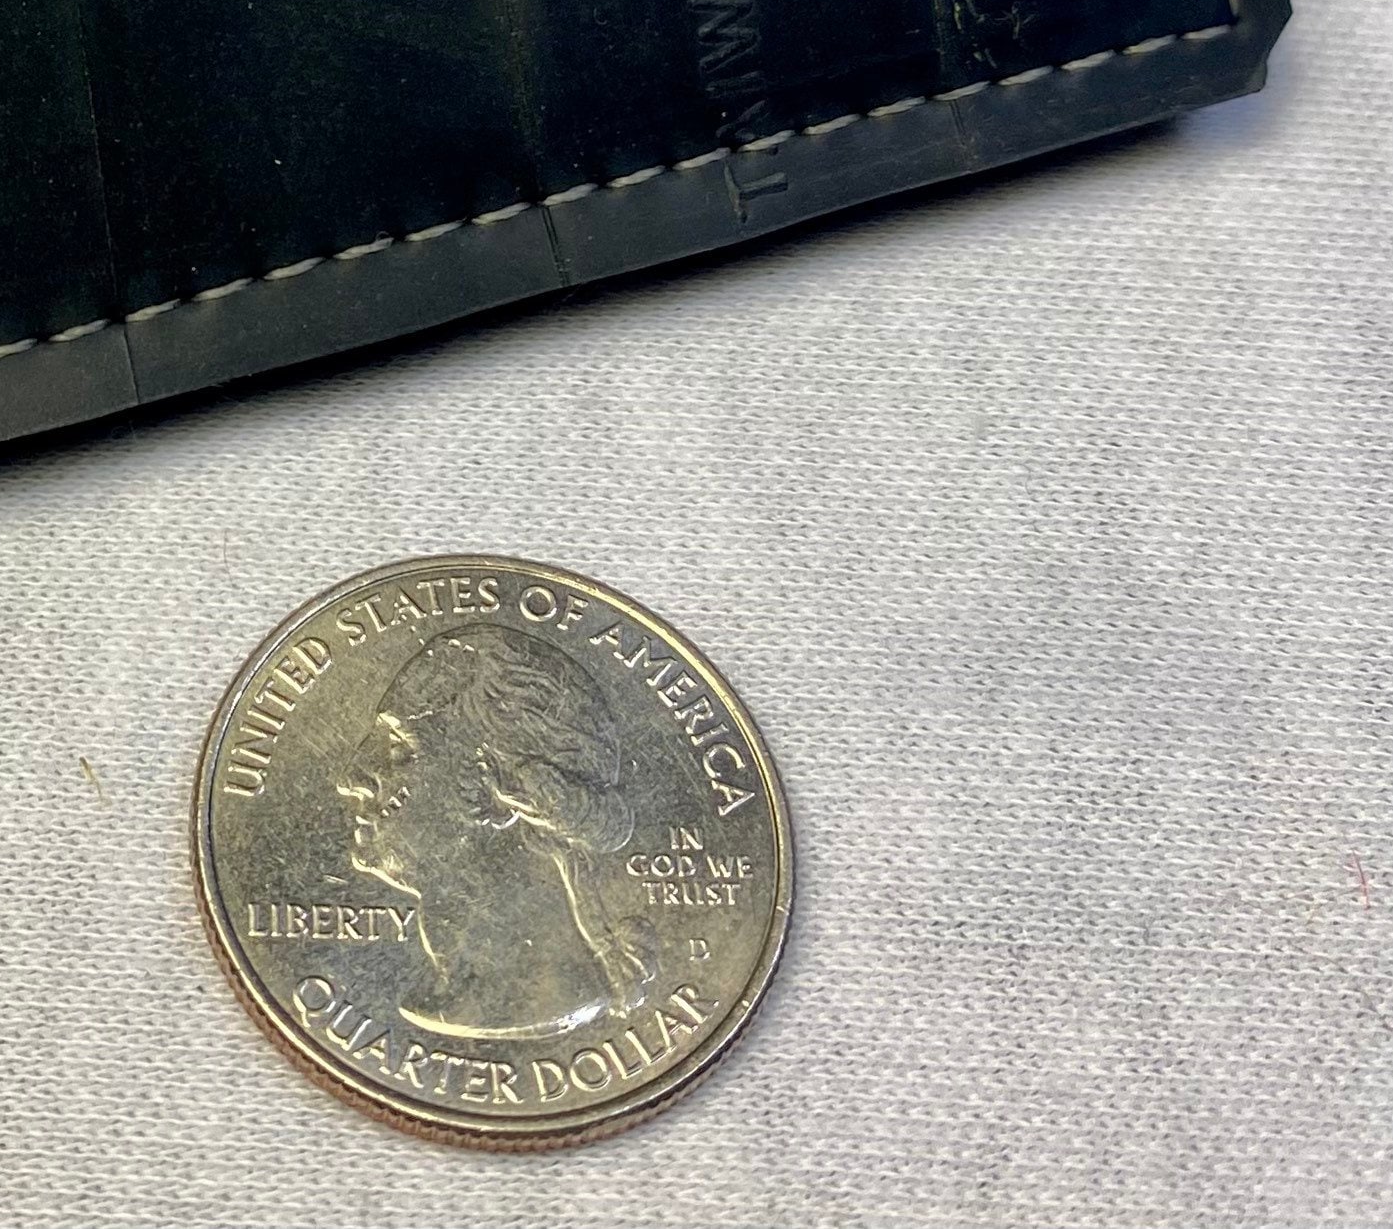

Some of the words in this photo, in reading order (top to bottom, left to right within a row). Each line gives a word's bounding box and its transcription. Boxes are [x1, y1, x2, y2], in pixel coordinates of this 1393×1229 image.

[224, 638, 333, 797] UNITED
[339, 577, 501, 647] STATES
[519, 585, 590, 631] OF
[591, 619, 757, 816] AMERICA
[669, 826, 704, 851] IN
[625, 854, 700, 880] GOD
[709, 857, 755, 880] WE
[642, 882, 741, 908] TRUST
[247, 904, 418, 943] LIBERTY
[688, 938, 711, 962] D
[292, 973, 525, 1105] QUARTER
[534, 983, 720, 1104] DOLLAR
